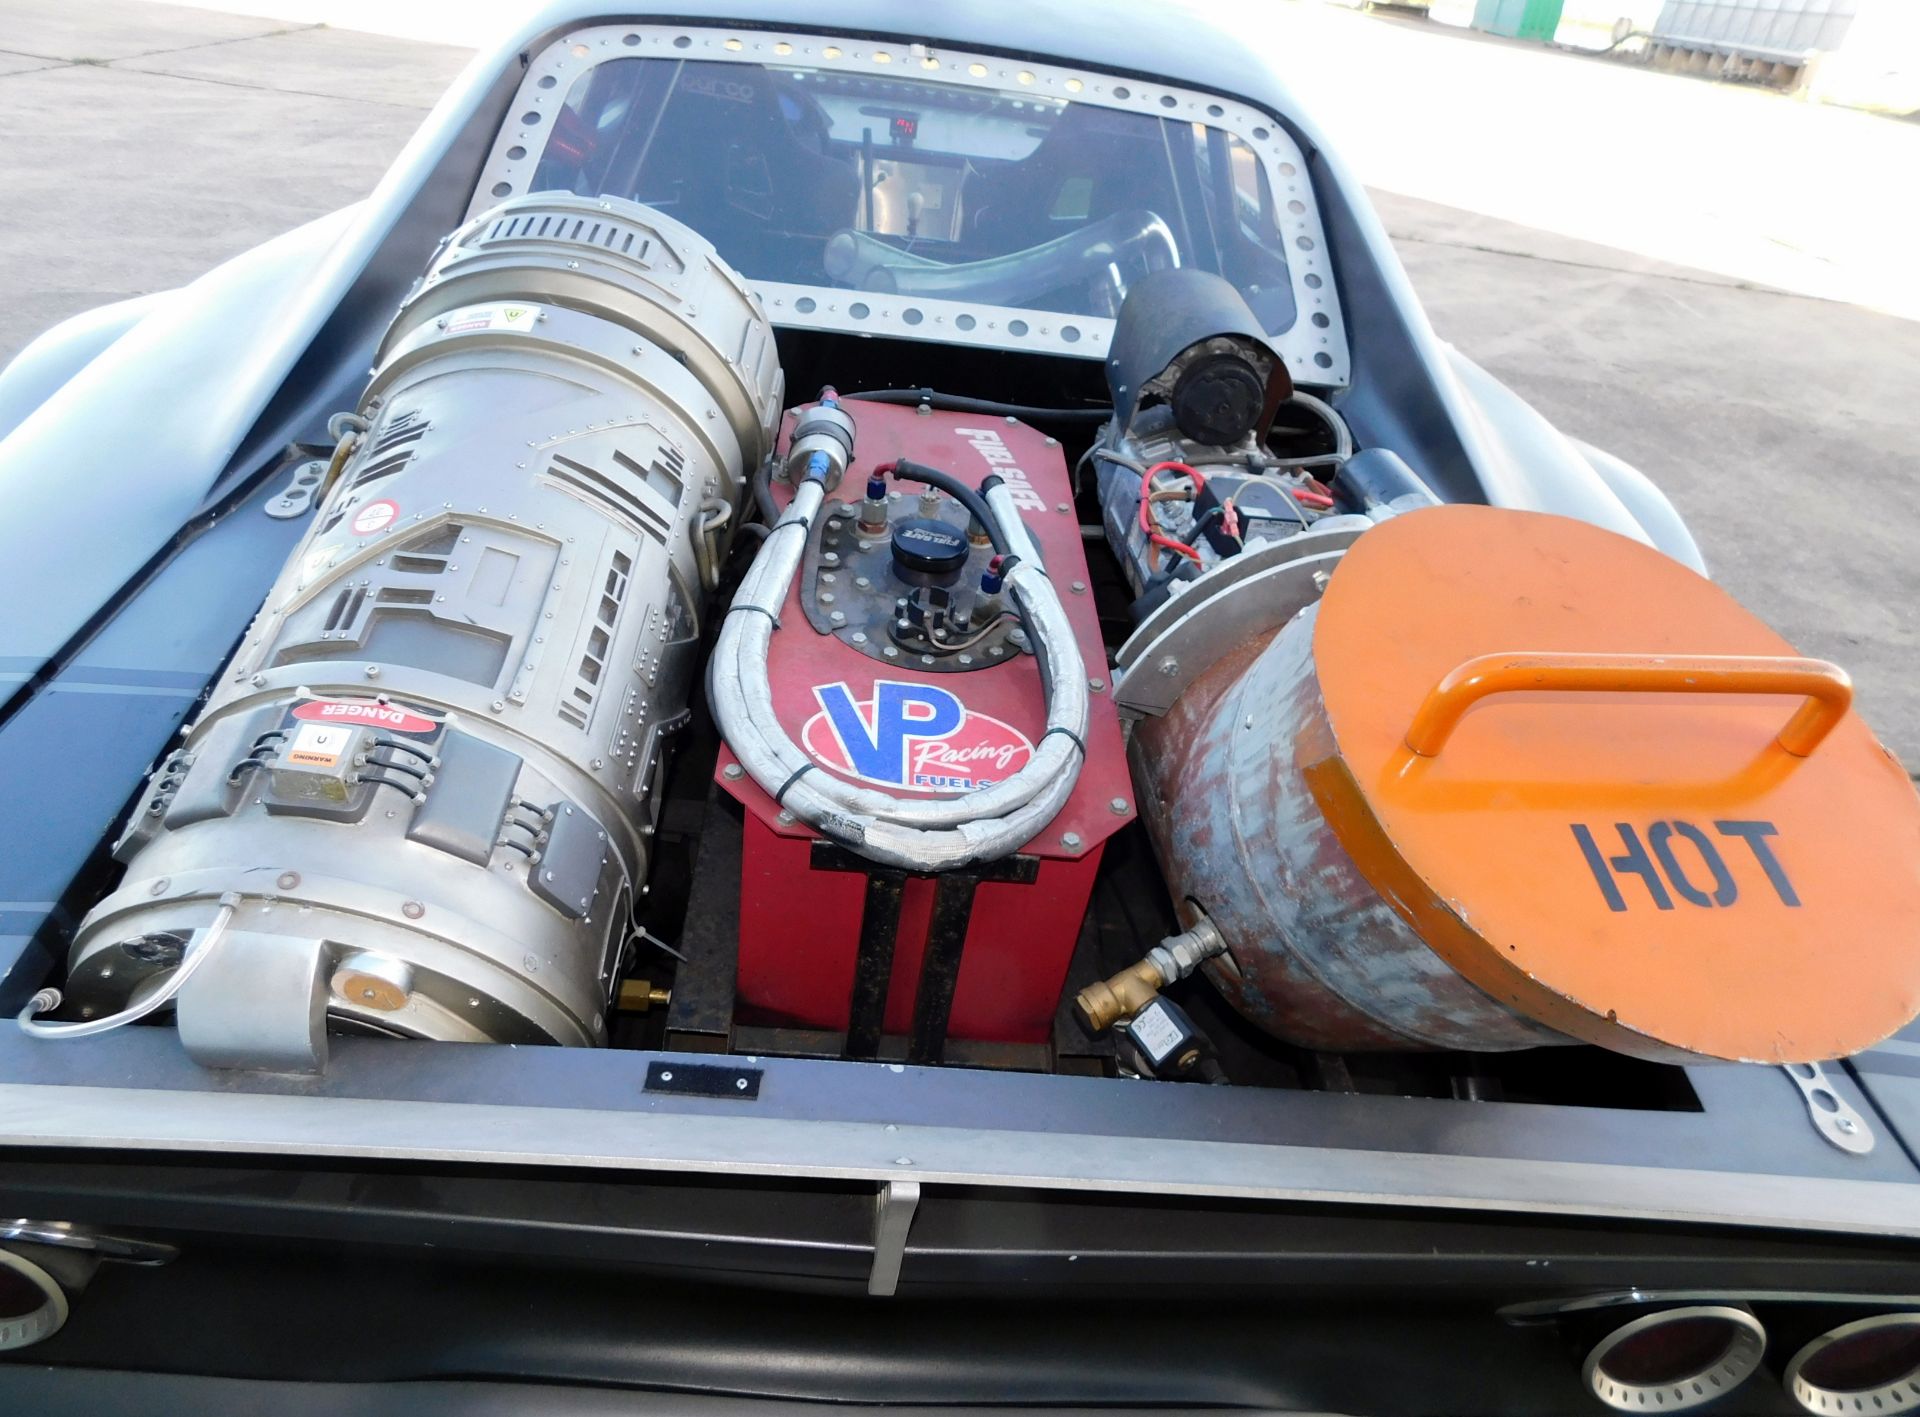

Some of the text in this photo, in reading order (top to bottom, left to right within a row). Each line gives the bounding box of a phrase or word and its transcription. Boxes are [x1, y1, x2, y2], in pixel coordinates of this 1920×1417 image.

[954, 427, 1016, 466] FUEL
[321, 704, 407, 724] DANGER
[811, 679, 967, 787] VP
[292, 753, 332, 764] WARNING
[913, 739, 1029, 773] Racing
[914, 774, 994, 790] FUELS
[1569, 820, 1802, 912] HOT
